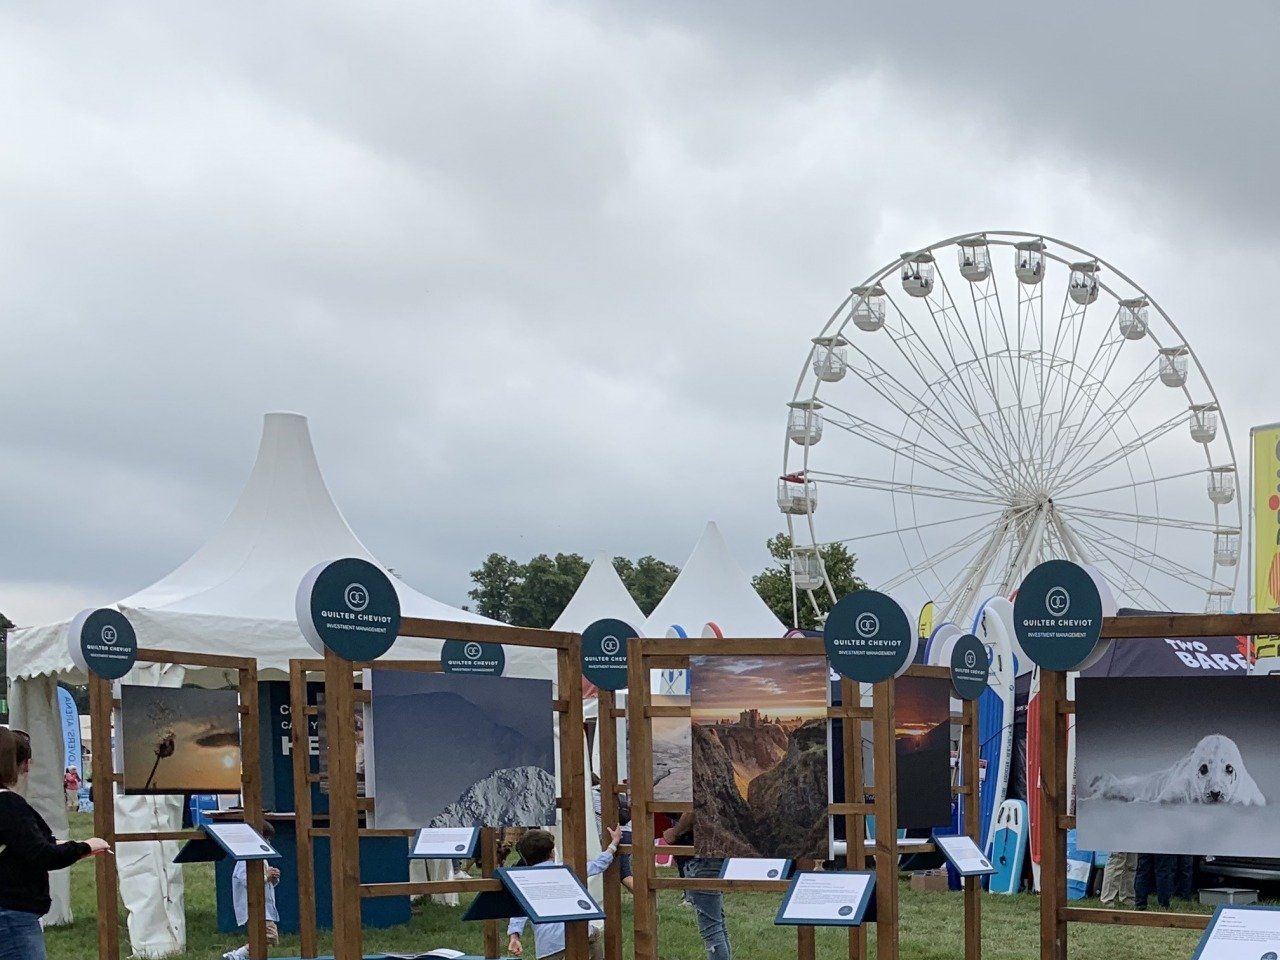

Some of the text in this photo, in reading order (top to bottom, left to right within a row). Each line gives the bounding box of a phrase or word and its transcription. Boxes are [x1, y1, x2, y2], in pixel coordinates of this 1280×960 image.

[321, 610, 392, 624] QUILTER CHEVIOT
[355, 625, 387, 633] MANAGEMENT
[1164, 638, 1208, 652] TWO
[1175, 651, 1253, 671] BARE
